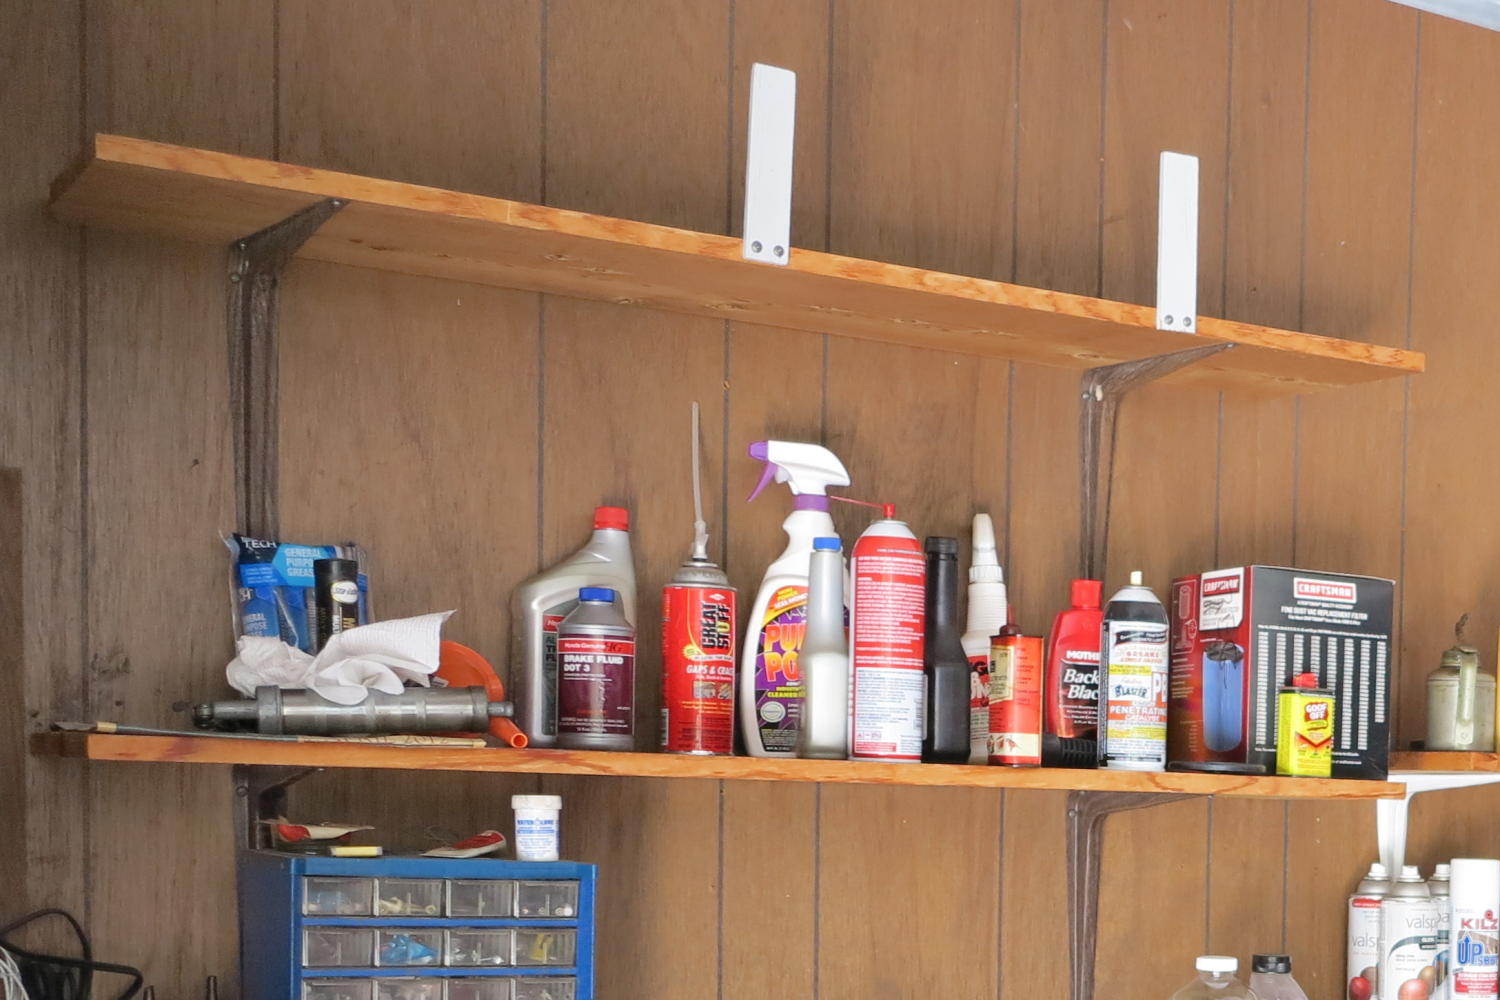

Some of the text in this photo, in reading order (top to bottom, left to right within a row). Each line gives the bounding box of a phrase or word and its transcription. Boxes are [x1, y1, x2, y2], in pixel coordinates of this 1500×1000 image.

[287, 567, 314, 577] GREAS
[1298, 583, 1353, 597] CRAFTSMAN
[715, 602, 731, 649] STUFF
[564, 654, 624, 665] BRAKE FLUID
[564, 663, 591, 672] DOT 3
[686, 664, 708, 675] GAPS
[709, 665, 717, 675] &
[1064, 668, 1100, 685] Back
[1068, 684, 1099, 701] Blac
[1308, 711, 1326, 720] OFF
[1406, 914, 1438, 931] valsp
[1461, 918, 1498, 930] KILZ
